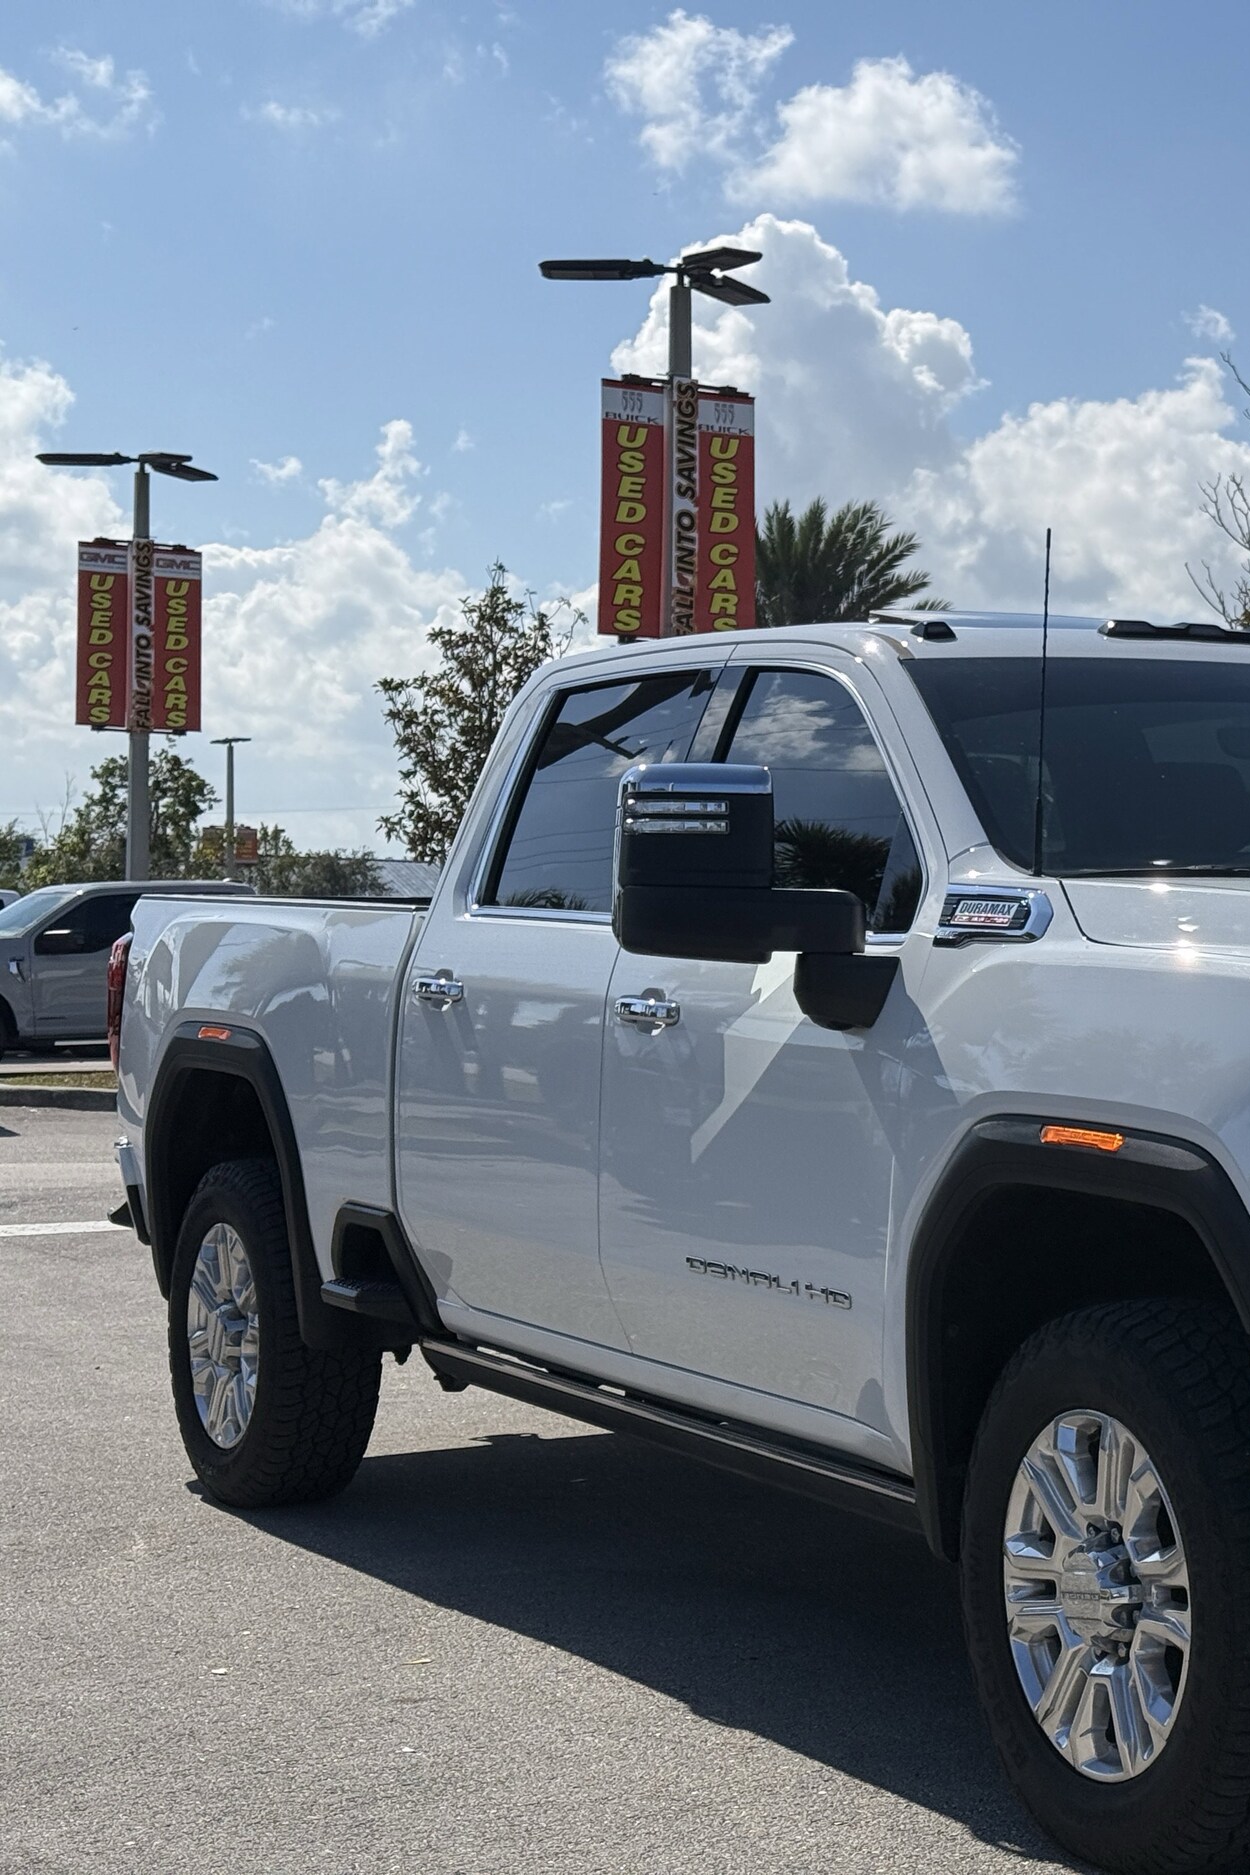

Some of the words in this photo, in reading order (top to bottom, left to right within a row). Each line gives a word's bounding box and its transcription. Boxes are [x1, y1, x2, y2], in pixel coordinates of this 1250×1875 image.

[605, 411, 659, 425] BUICK
[676, 382, 697, 501] SAVINGS
[615, 424, 649, 524] USED
[709, 436, 740, 534] USED
[80, 552, 128, 565] GMC
[156, 558, 201, 571] GMC
[676, 510, 696, 579] INTO
[89, 574, 115, 645] USED
[136, 541, 152, 627] SAVINGS
[164, 580, 190, 651] USED
[611, 533, 647, 632] CARS
[86, 652, 113, 723] CARS
[136, 635, 151, 682] INTO
[163, 657, 188, 728] CARS
[136, 690, 152, 729] FALL
[958, 902, 1015, 916] DURAMAX
[685, 1255, 799, 1297] DENALI
[804, 1281, 852, 1310] HD
